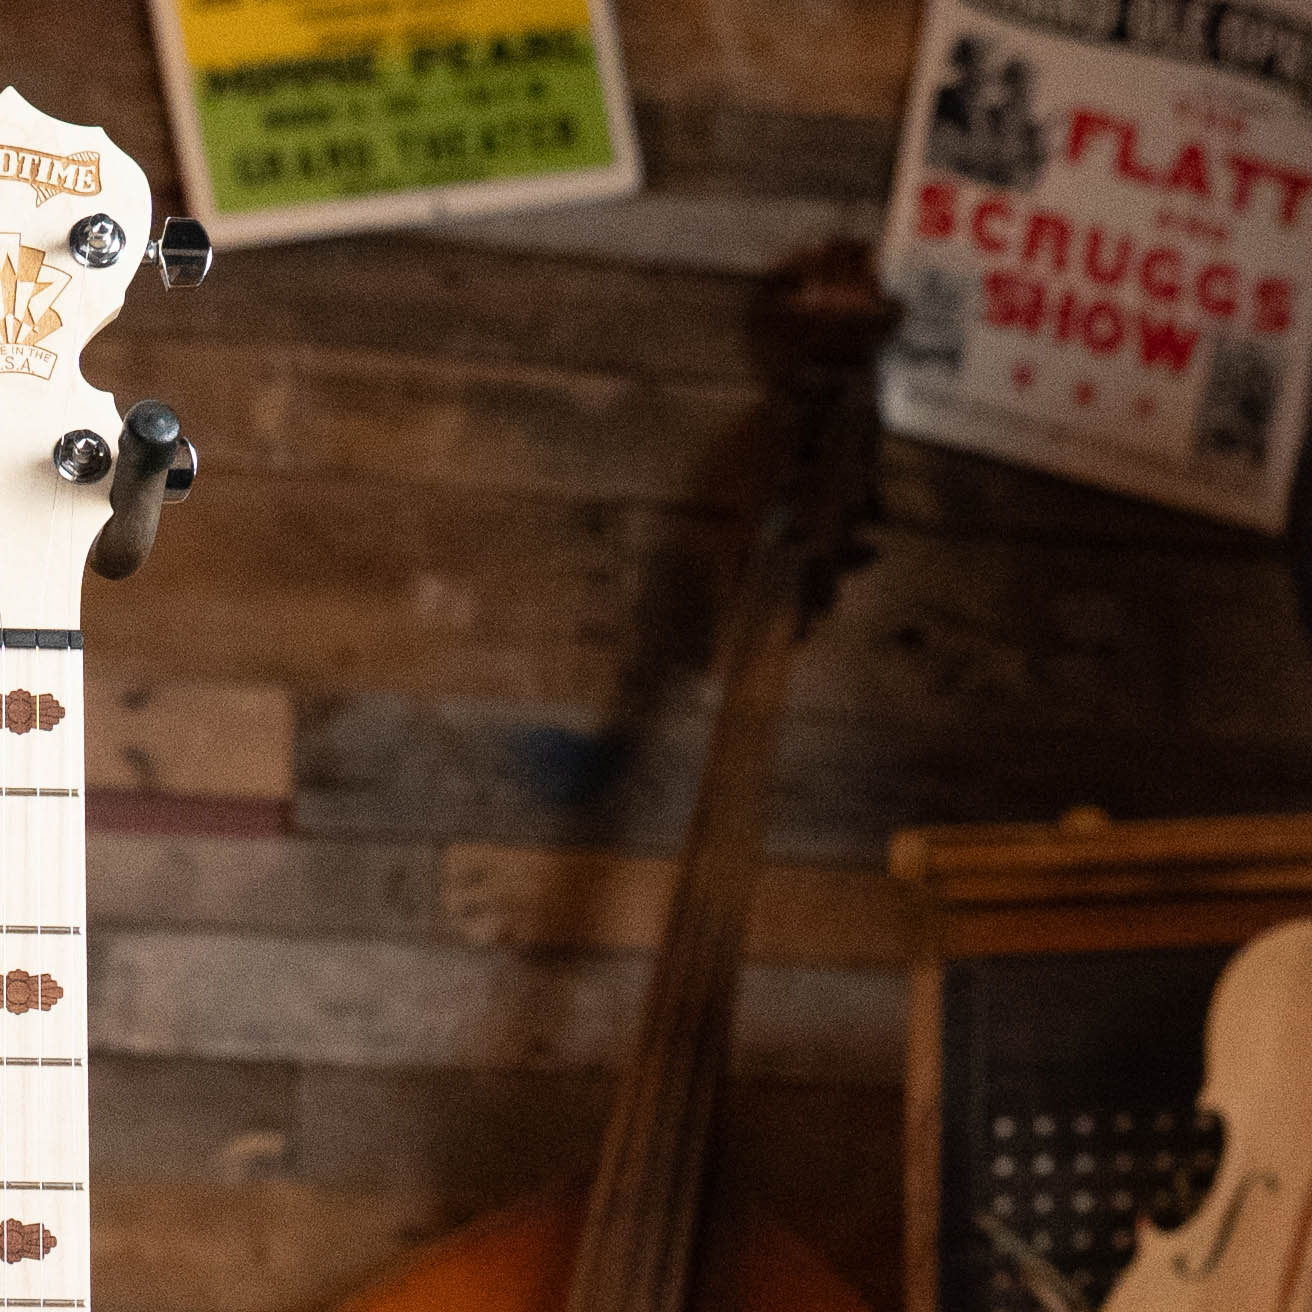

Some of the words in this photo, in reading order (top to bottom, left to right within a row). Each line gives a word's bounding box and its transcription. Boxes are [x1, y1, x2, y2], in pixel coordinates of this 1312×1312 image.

[919, 179, 1293, 333] SCRUGGS
[11, 346, 24, 356] IN
[28, 348, 52, 364] THE
[982, 268, 1199, 372] SHOW
